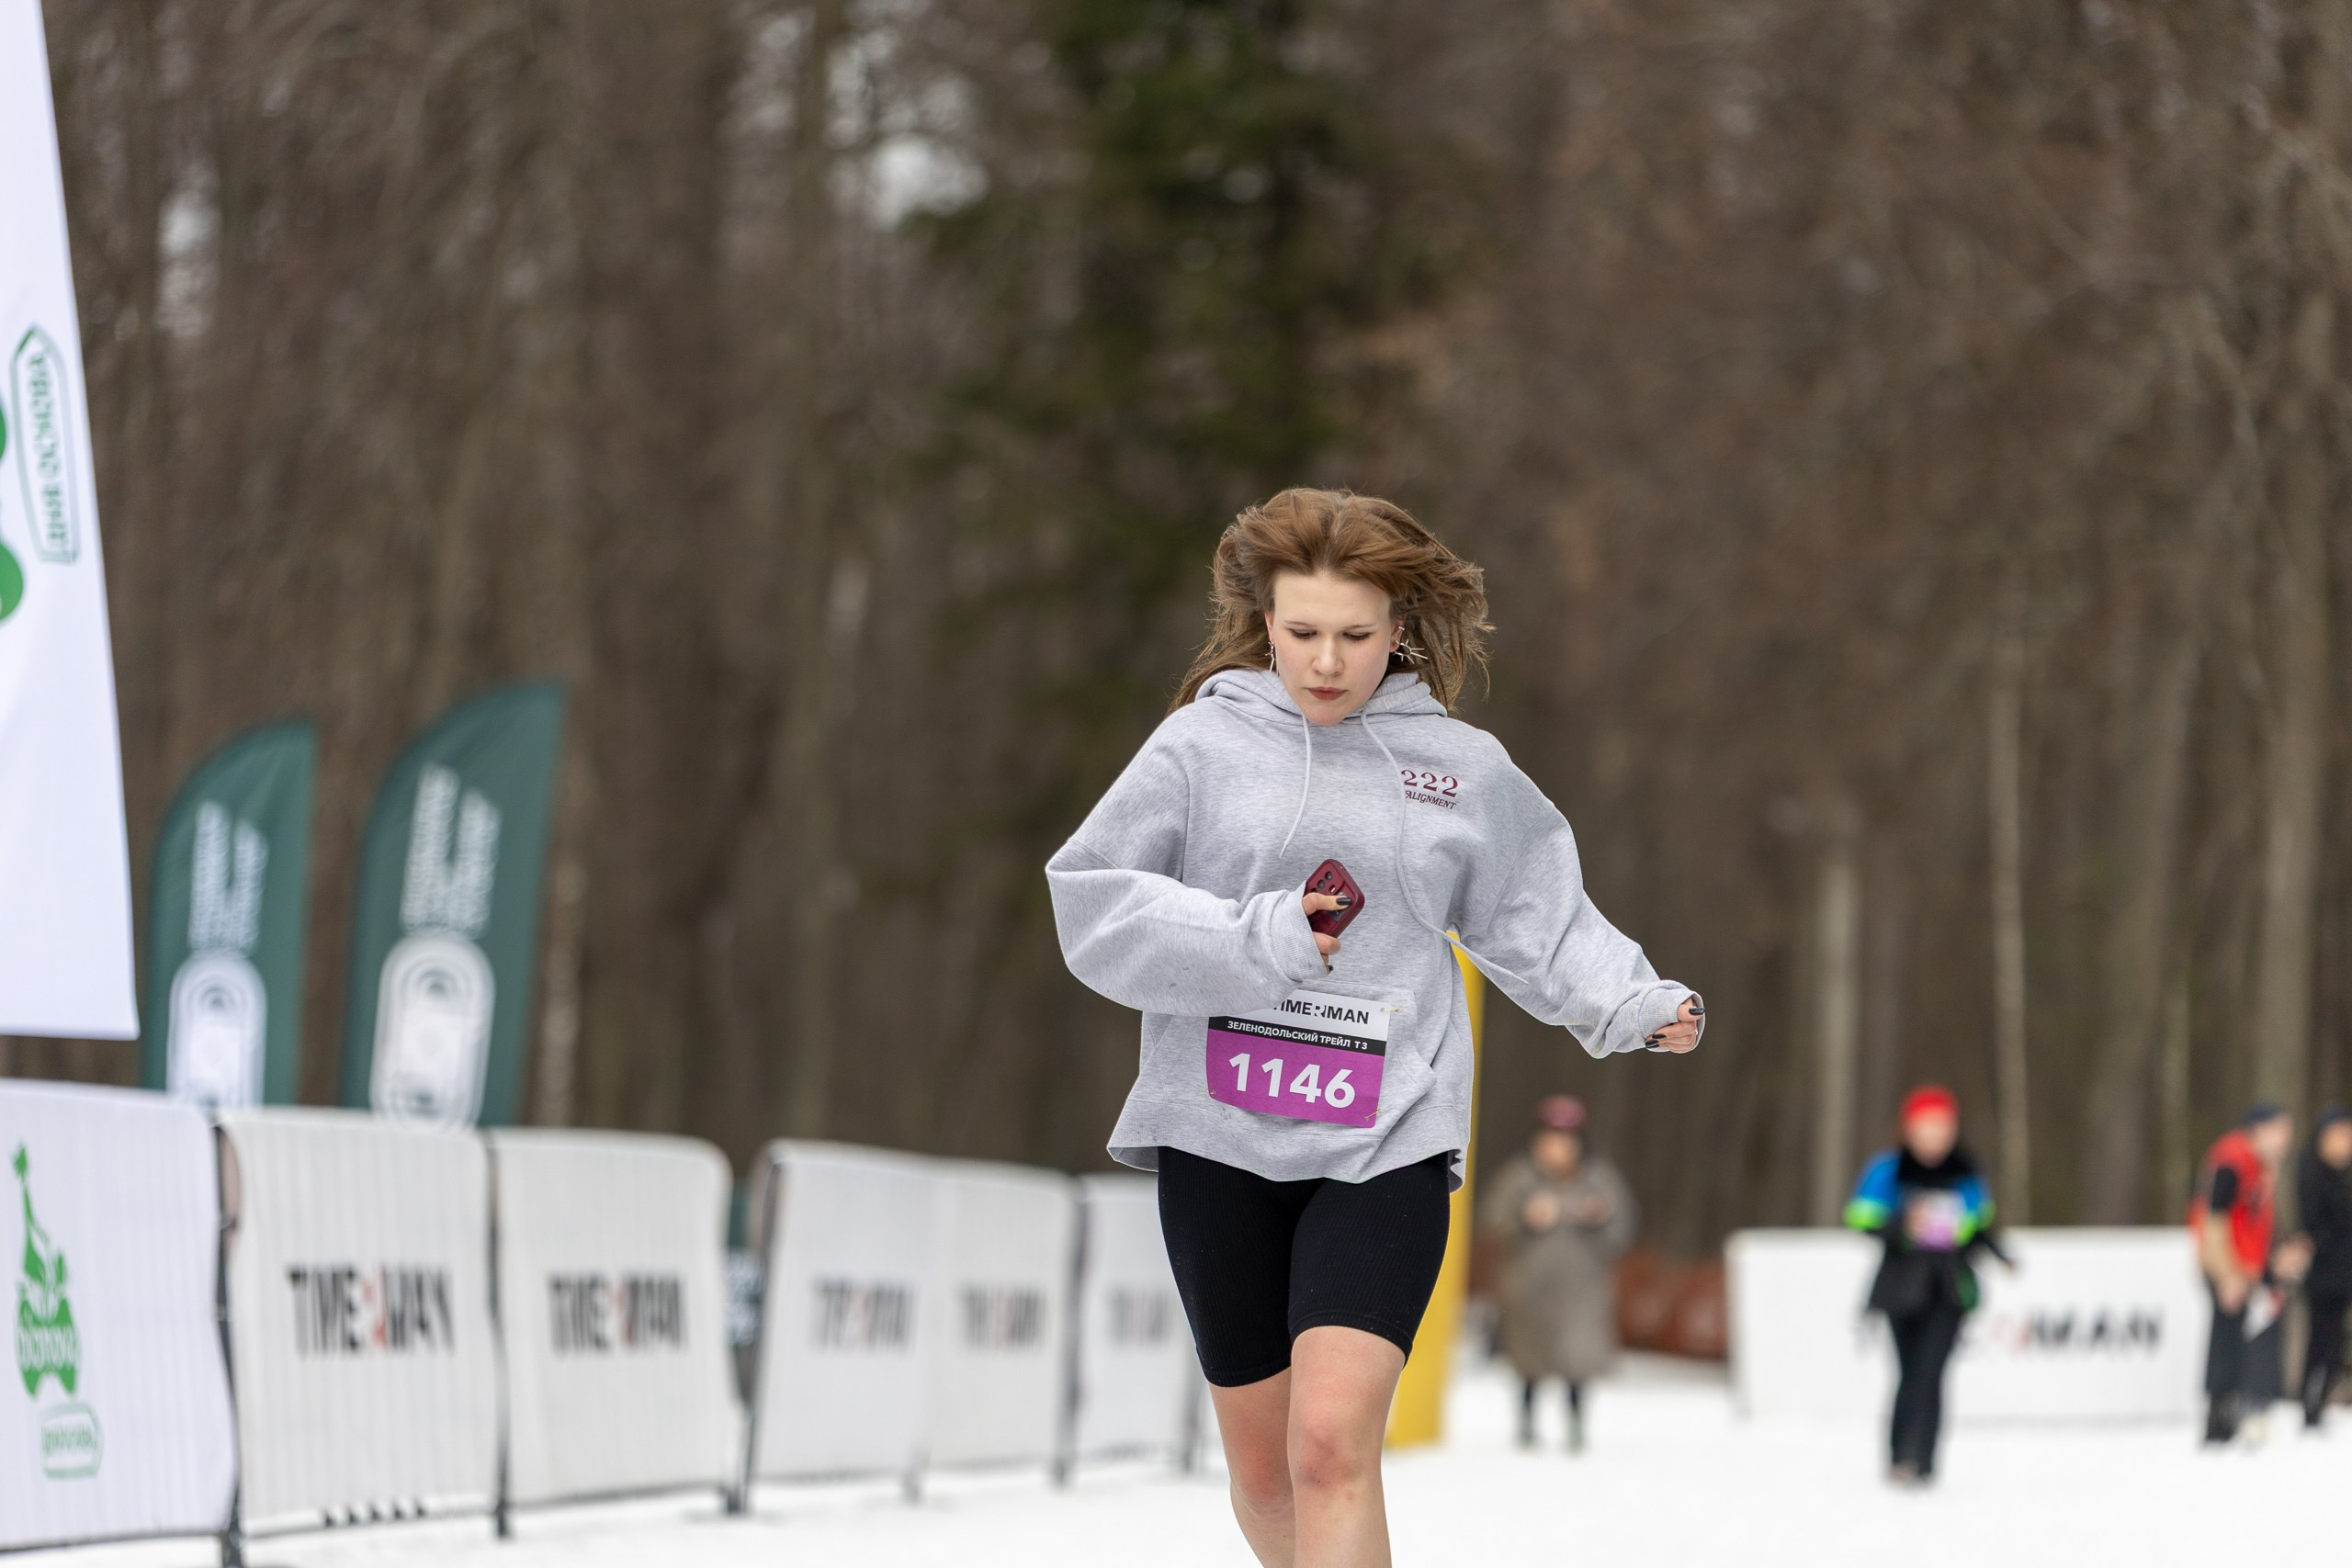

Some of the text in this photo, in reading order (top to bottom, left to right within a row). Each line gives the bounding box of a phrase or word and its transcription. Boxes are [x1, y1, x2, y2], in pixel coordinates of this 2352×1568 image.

[1401, 769, 1459, 798] 222
[1227, 1021, 1318, 1043] ЗЕЛЕНОДОЛЬСКИЙ
[1320, 1035, 1351, 1048] ТРЕЙЛ
[1228, 1053, 1355, 1109] 1146
